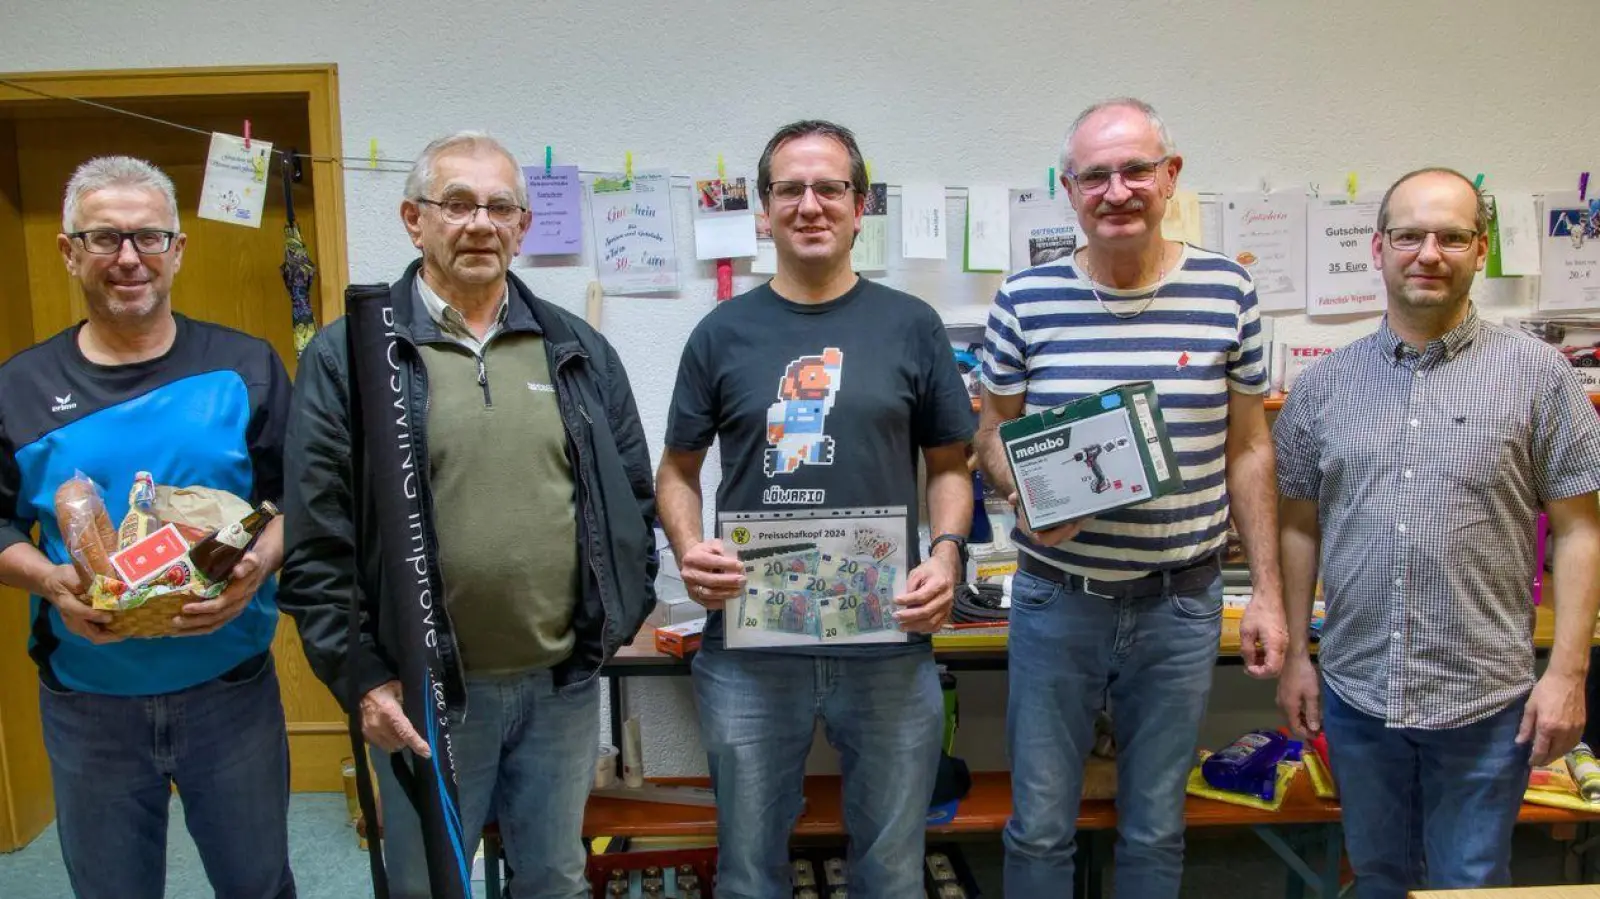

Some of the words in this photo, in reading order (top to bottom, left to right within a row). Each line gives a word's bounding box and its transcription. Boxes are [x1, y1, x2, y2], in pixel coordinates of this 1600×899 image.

[1325, 226, 1374, 237] Gutschein
[1339, 239, 1358, 248] von
[1328, 263, 1341, 272] 35
[1345, 262, 1368, 271] Euro
[1015, 437, 1065, 459] metabo
[763, 486, 825, 504] LÖWARIO
[758, 531, 822, 540] Preisschafkopf
[824, 530, 846, 538] 2024
[764, 562, 784, 577] 20
[838, 559, 859, 574] 20
[405, 513, 438, 648] improve
[806, 577, 827, 592] 20
[766, 591, 785, 606] 20
[839, 596, 858, 611] 20
[745, 618, 758, 628] 20
[825, 628, 838, 638] 20
